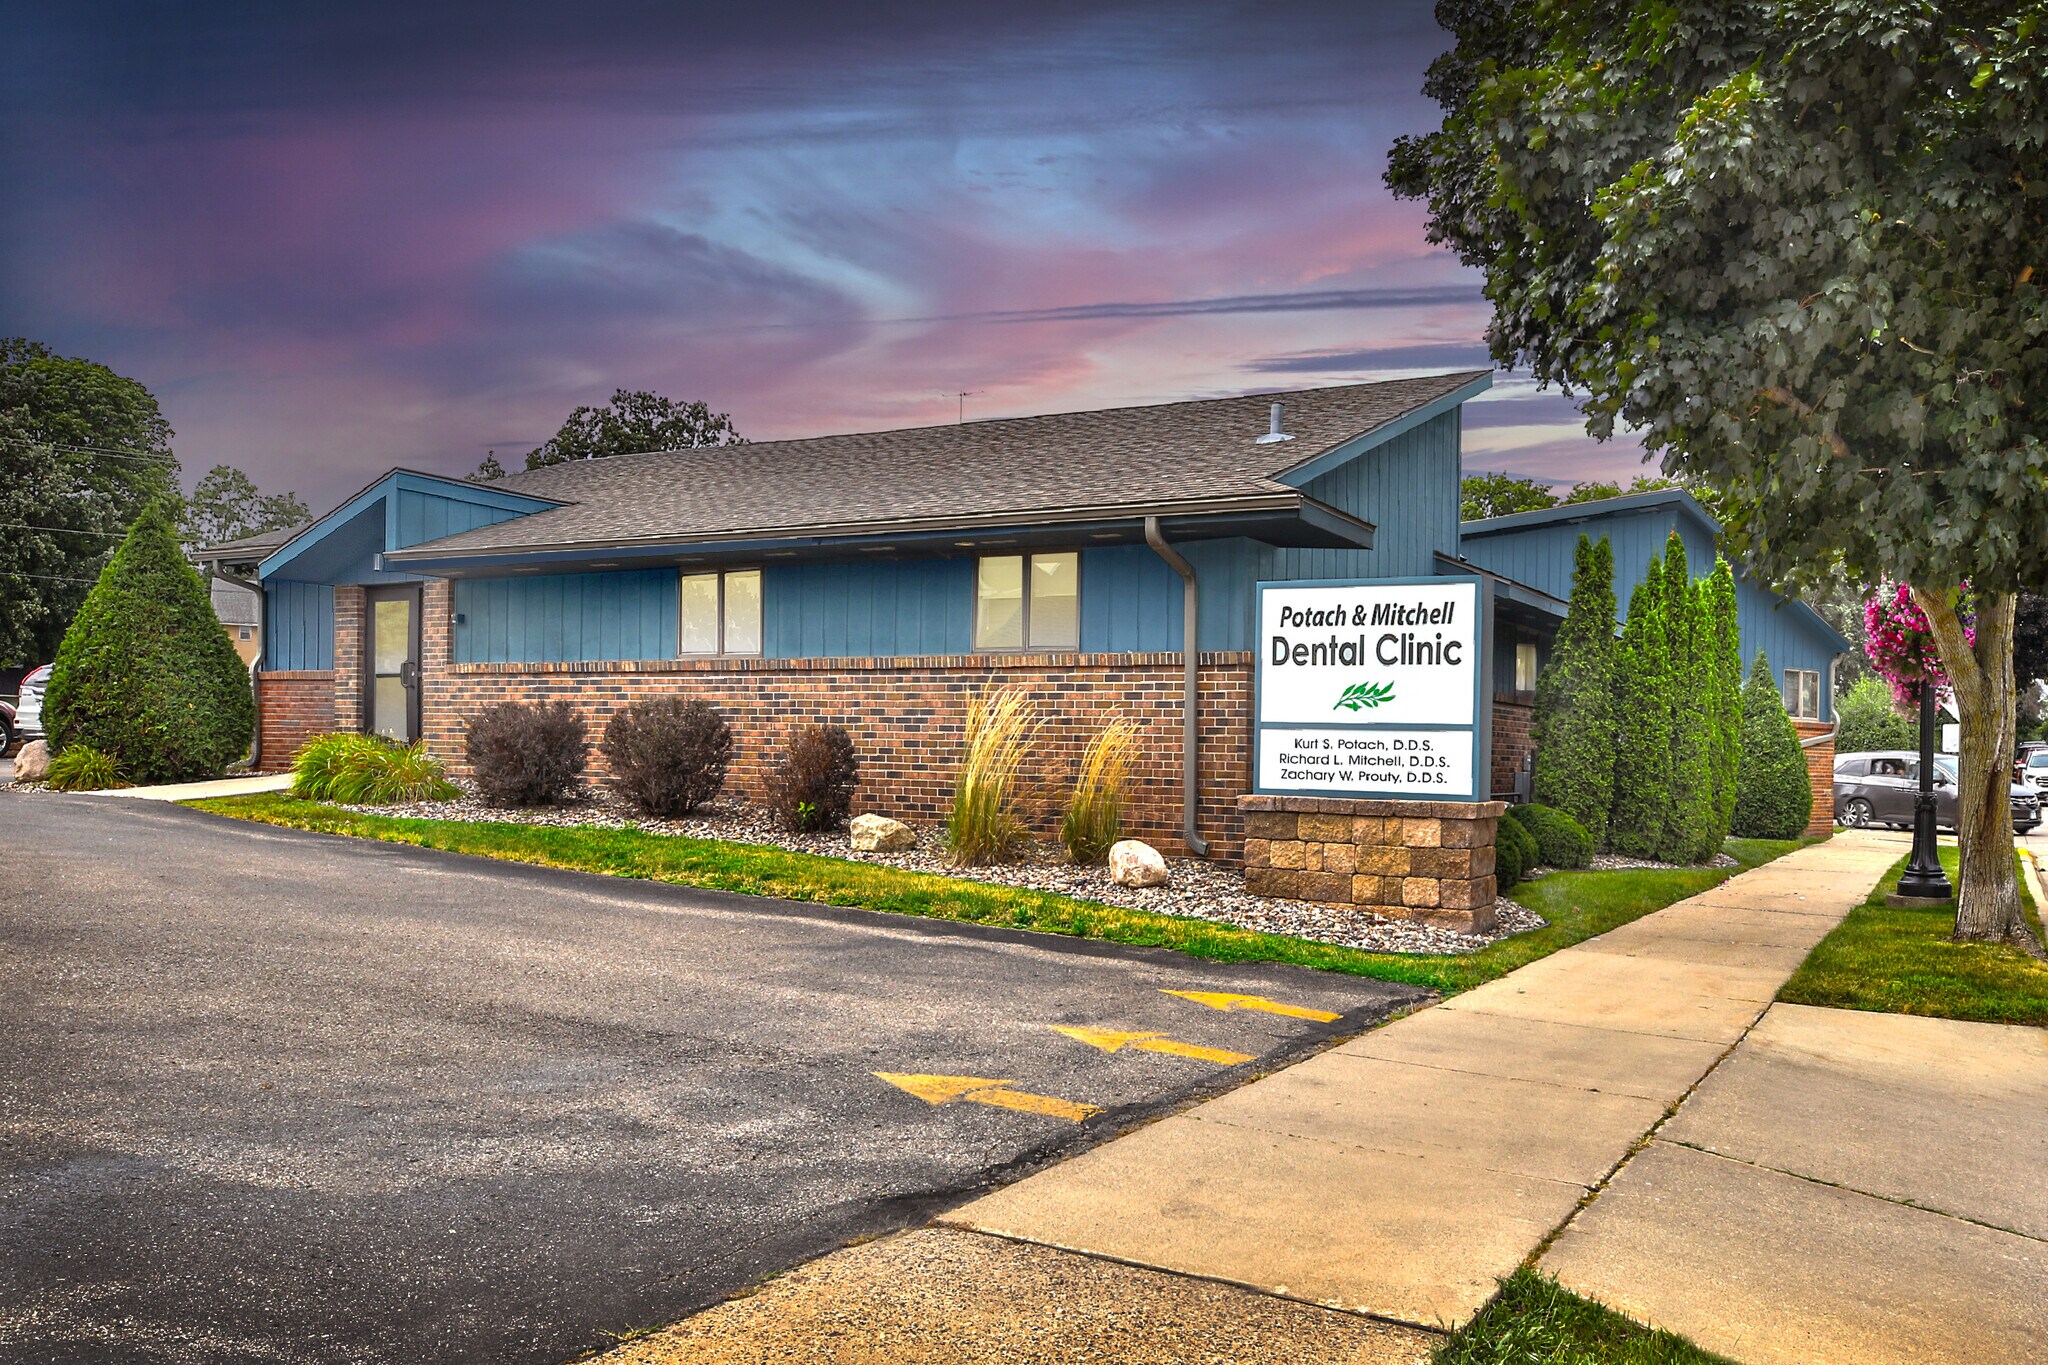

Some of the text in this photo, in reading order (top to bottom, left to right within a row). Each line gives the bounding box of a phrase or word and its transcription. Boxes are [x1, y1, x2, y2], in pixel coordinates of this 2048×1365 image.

[1280, 602, 1455, 627] Potach & Mitchell
[1272, 633, 1462, 666] Dental Clinic
[1294, 738, 1434, 751] Kurt S. Potach, D.D.S.
[1279, 754, 1450, 768] Richard L. Mitchell, D.D.S.
[1281, 769, 1448, 784] Zachary W. Prouty, D.D.S.
